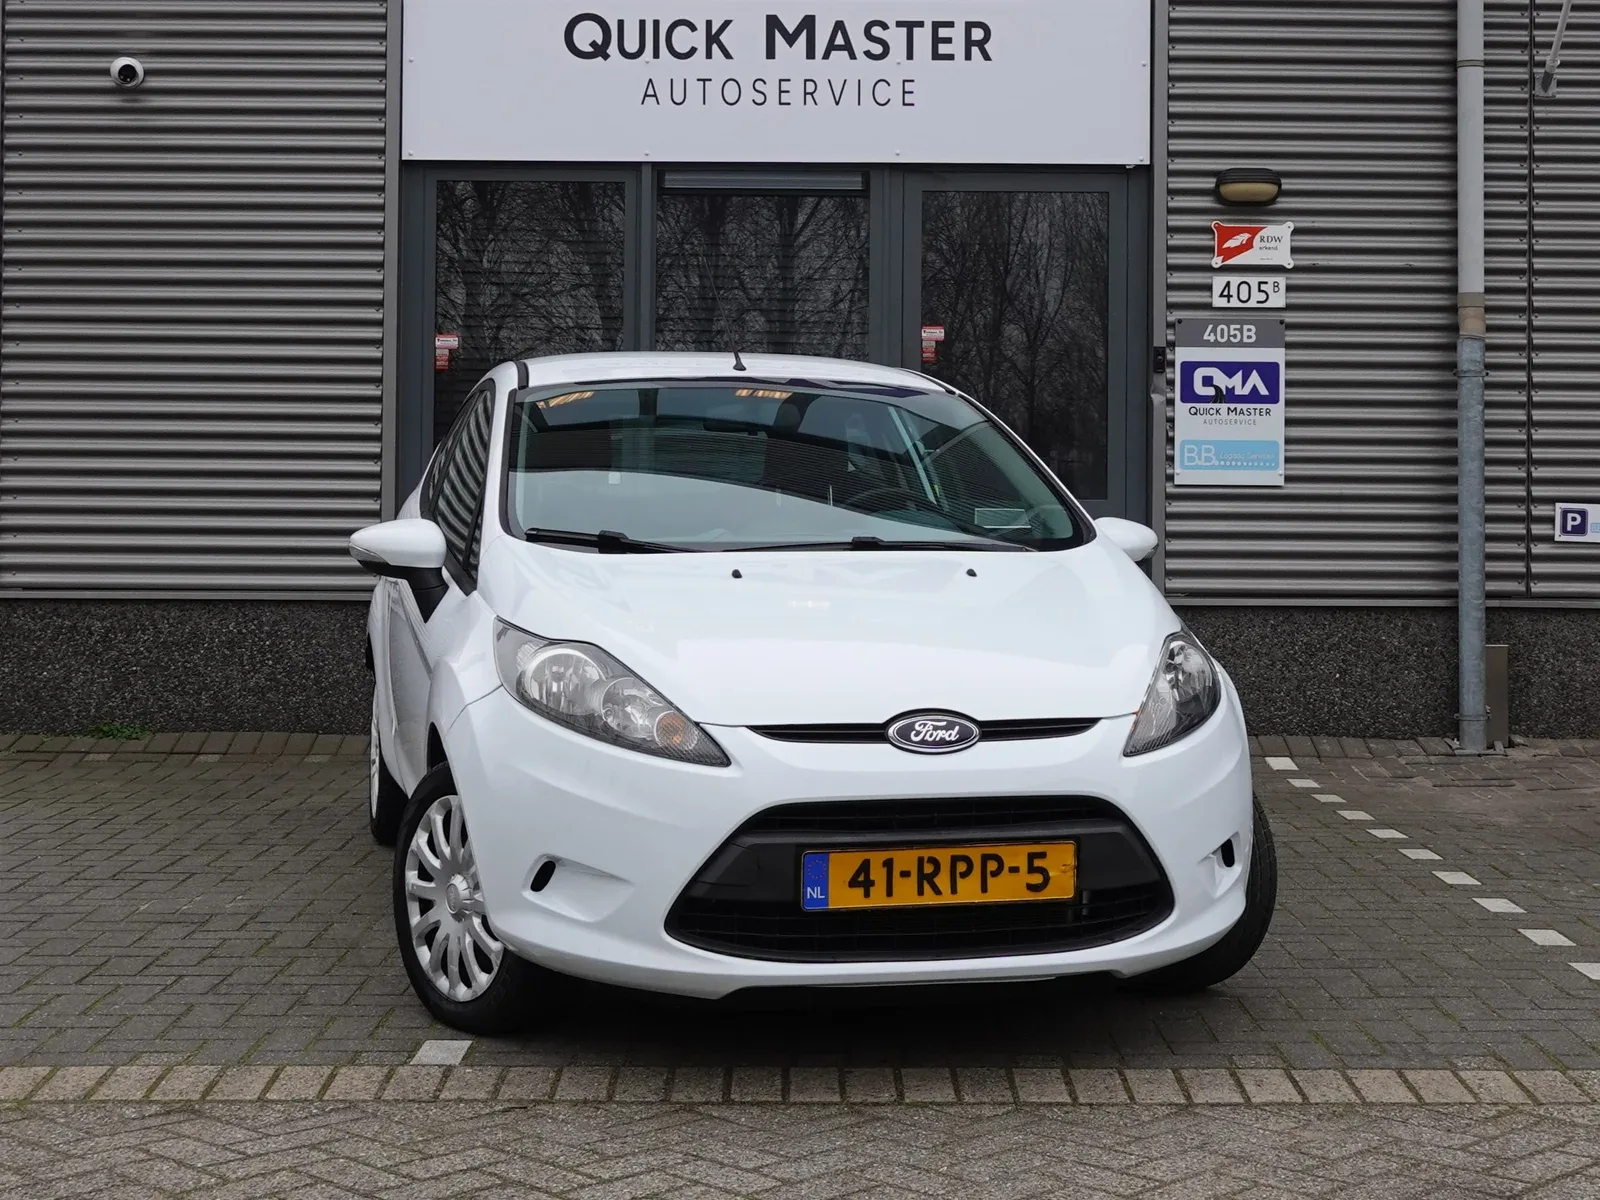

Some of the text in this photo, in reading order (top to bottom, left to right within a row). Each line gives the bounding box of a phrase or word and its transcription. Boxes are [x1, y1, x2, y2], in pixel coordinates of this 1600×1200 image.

[564, 13, 993, 61] QUICK MASTER
[641, 78, 915, 106] AUTOSERVICE
[1259, 235, 1283, 243] RDW
[1203, 324, 1257, 343] 405B
[1188, 406, 1272, 417] QUICK MASTER
[1203, 418, 1257, 426] AUTOSERVICE
[1566, 512, 1582, 532] P
[910, 720, 960, 742] Ford
[806, 851, 1051, 899] NL 41-RPP-5
